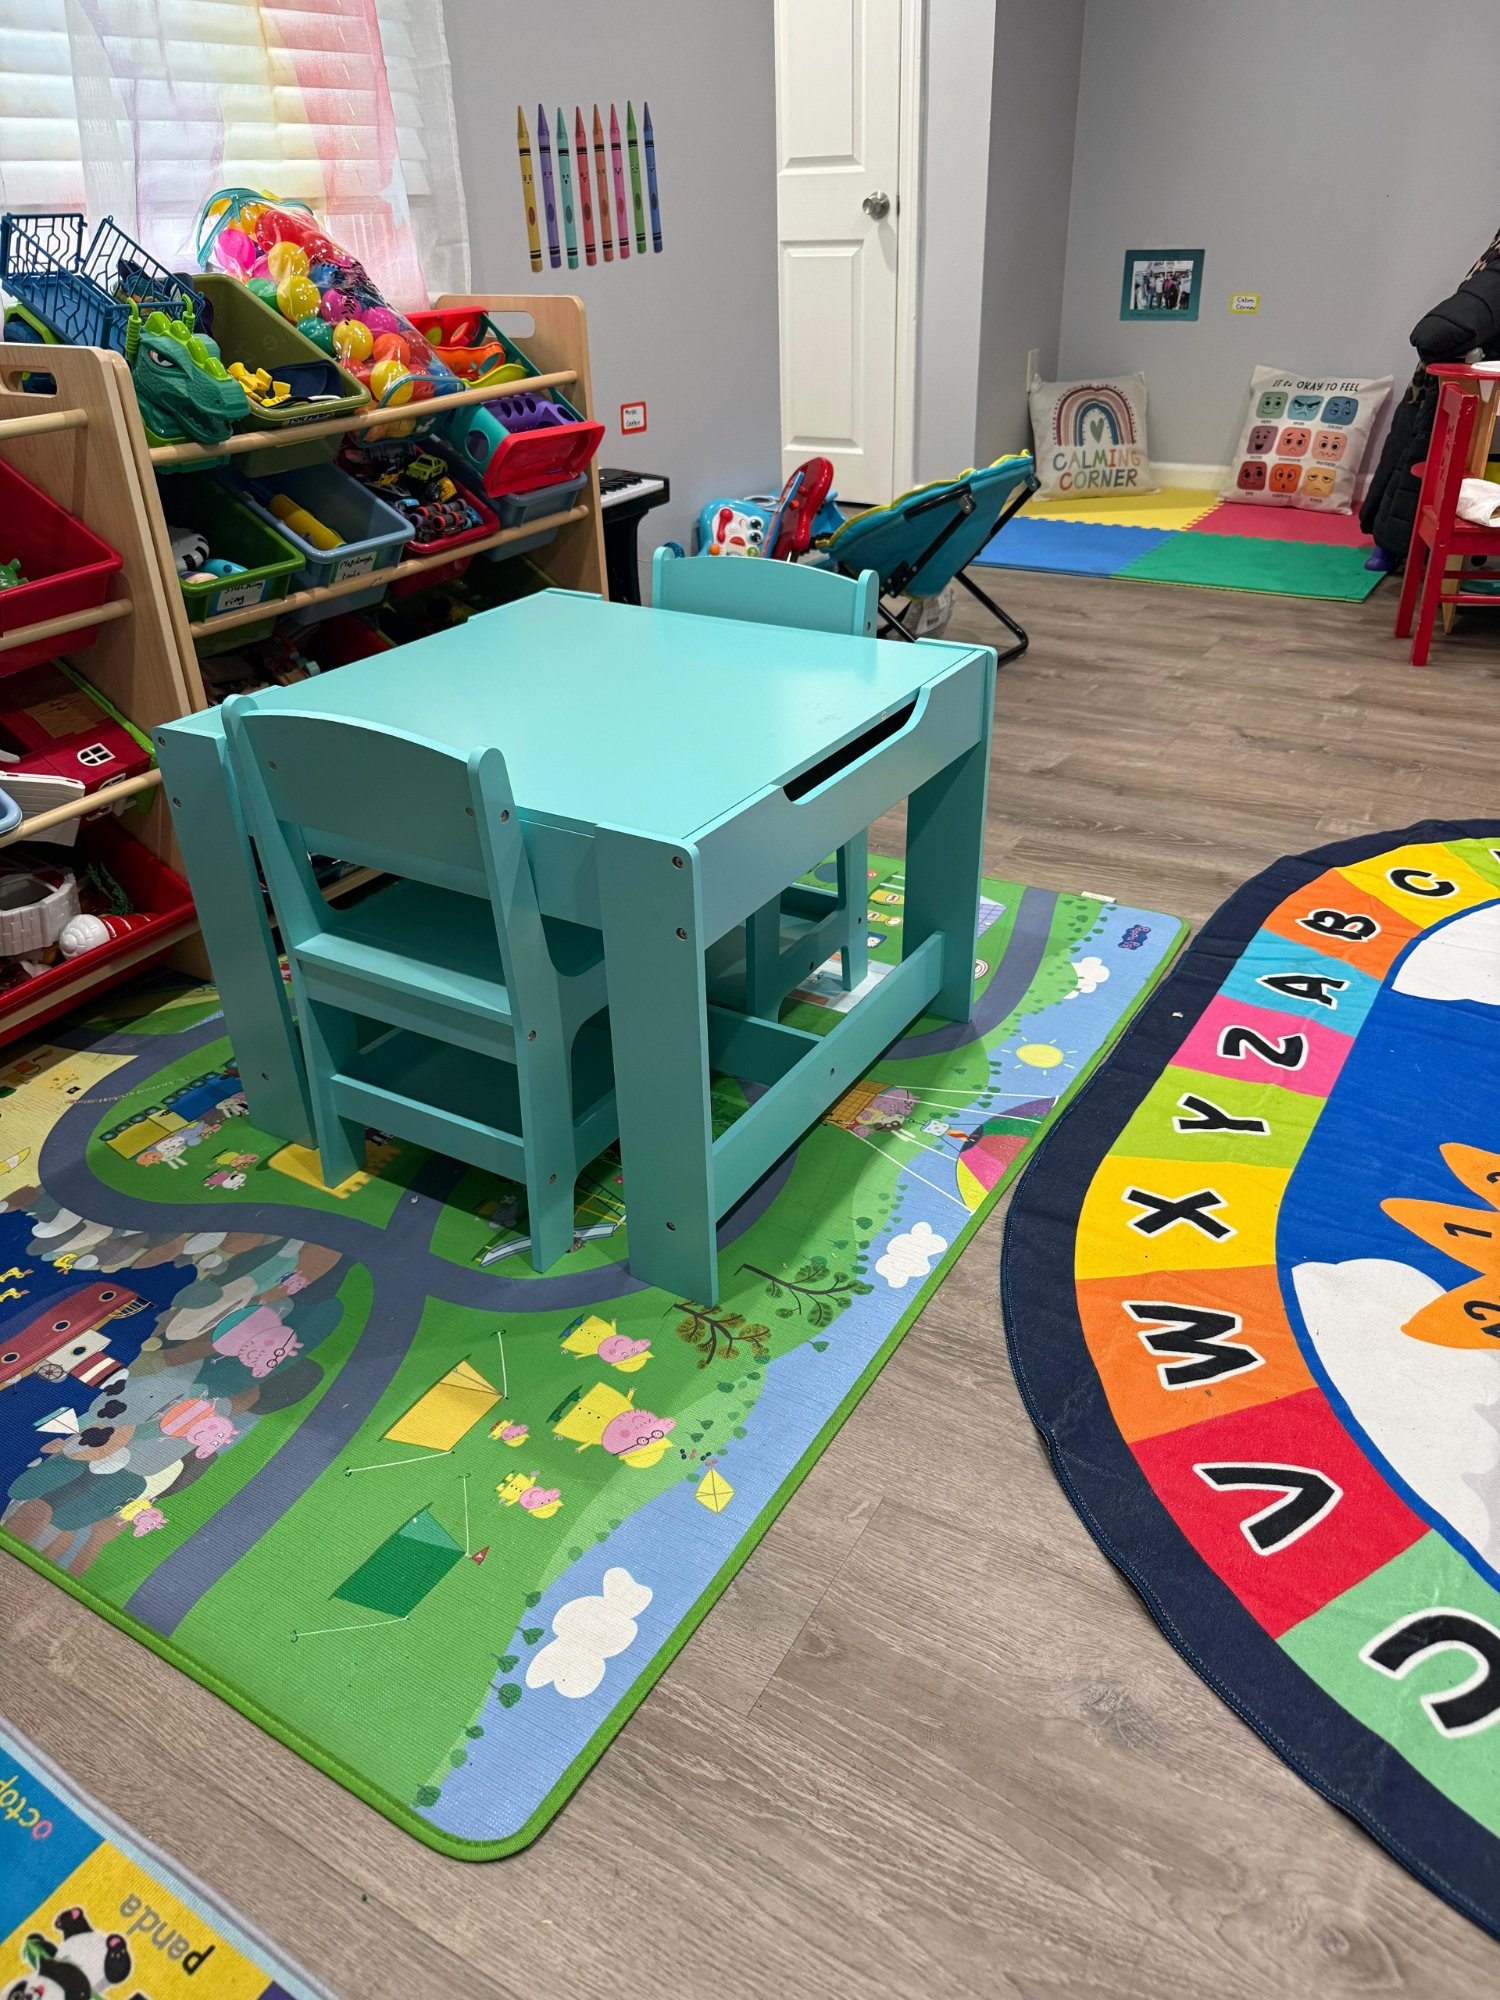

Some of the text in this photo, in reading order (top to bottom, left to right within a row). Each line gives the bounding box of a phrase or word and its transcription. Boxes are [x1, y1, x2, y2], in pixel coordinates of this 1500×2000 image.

[1296, 381, 1323, 391] OKAY
[1325, 382, 1337, 391] TO
[1339, 382, 1359, 392] FEEL
[1052, 448, 1142, 472] CALMING
[1060, 468, 1138, 491] CORNER
[1388, 868, 1457, 897] C
[1298, 909, 1379, 941] B
[1259, 974, 1348, 1008] A
[1219, 1026, 1306, 1069] Z
[1175, 1094, 1268, 1134] Y
[1124, 1188, 1234, 1240] X
[1444, 1222, 1492, 1238] 1
[1125, 1302, 1261, 1387] W
[1197, 1465, 1339, 1552] V
[1365, 1610, 1500, 1734] U
[119, 1893, 216, 1976] panda
